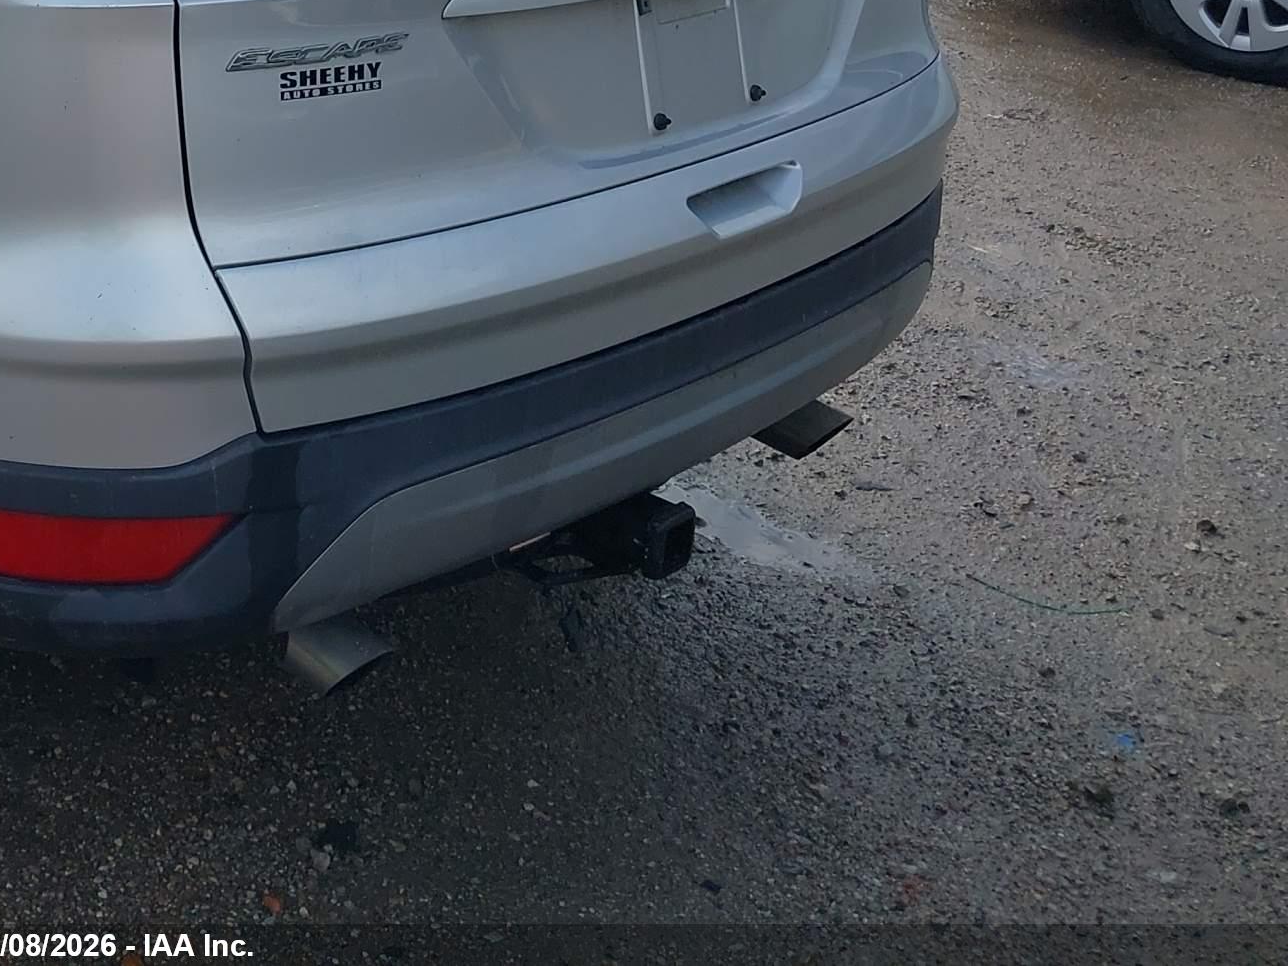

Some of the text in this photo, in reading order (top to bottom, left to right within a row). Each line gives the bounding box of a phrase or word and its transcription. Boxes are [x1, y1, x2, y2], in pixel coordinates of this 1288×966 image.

[225, 32, 409, 72] ESCAPE
[279, 62, 382, 89] SHEEHY
[282, 81, 381, 101] AUTO STORES
